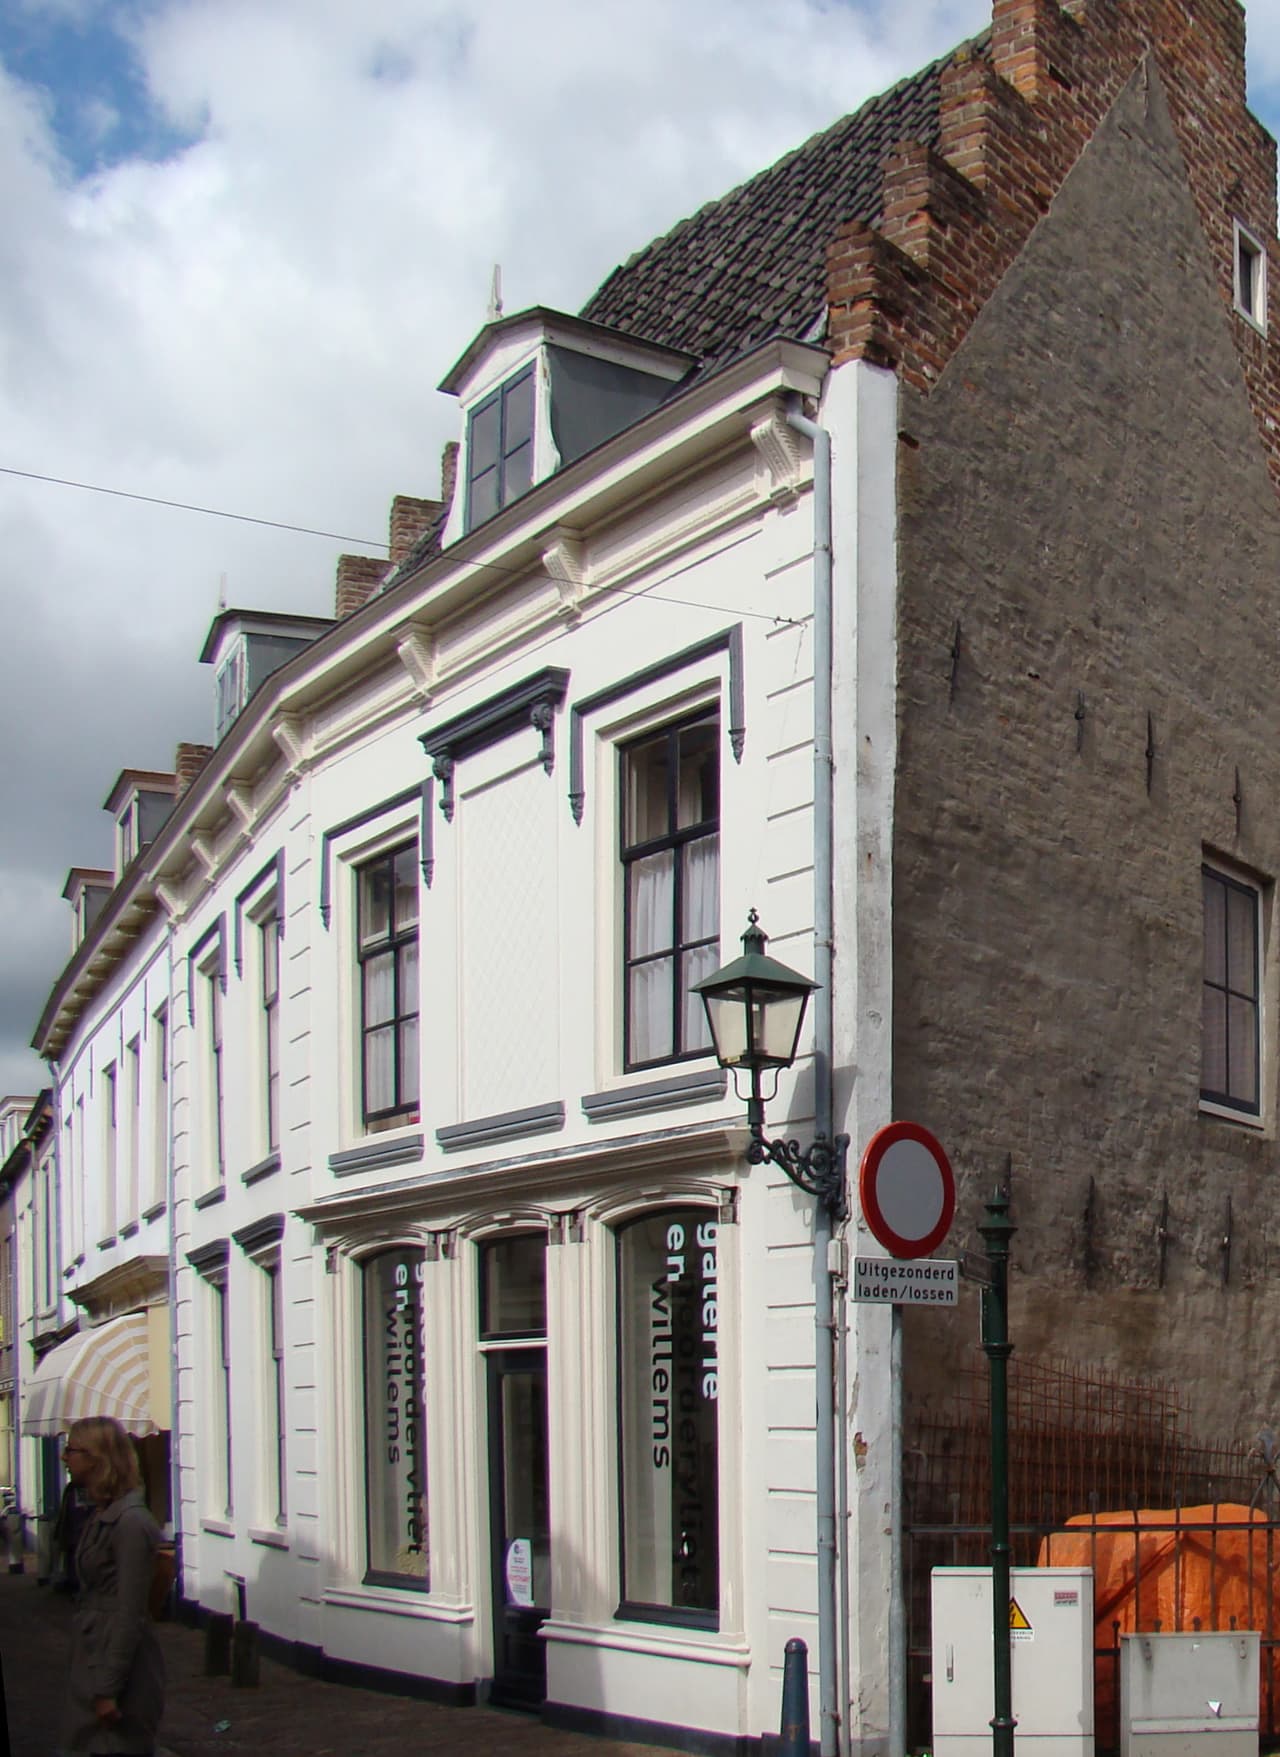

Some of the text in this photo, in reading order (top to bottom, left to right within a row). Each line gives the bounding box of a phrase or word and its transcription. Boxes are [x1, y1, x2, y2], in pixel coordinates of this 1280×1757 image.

[666, 1223, 685, 1281] en
[857, 1262, 954, 1281] Uitgezonderd
[395, 1264, 408, 1312] en
[696, 1220, 719, 1399] galerie
[858, 1283, 954, 1300] laden/lossen
[385, 1305, 403, 1465] willems
[651, 1277, 673, 1468] willems
